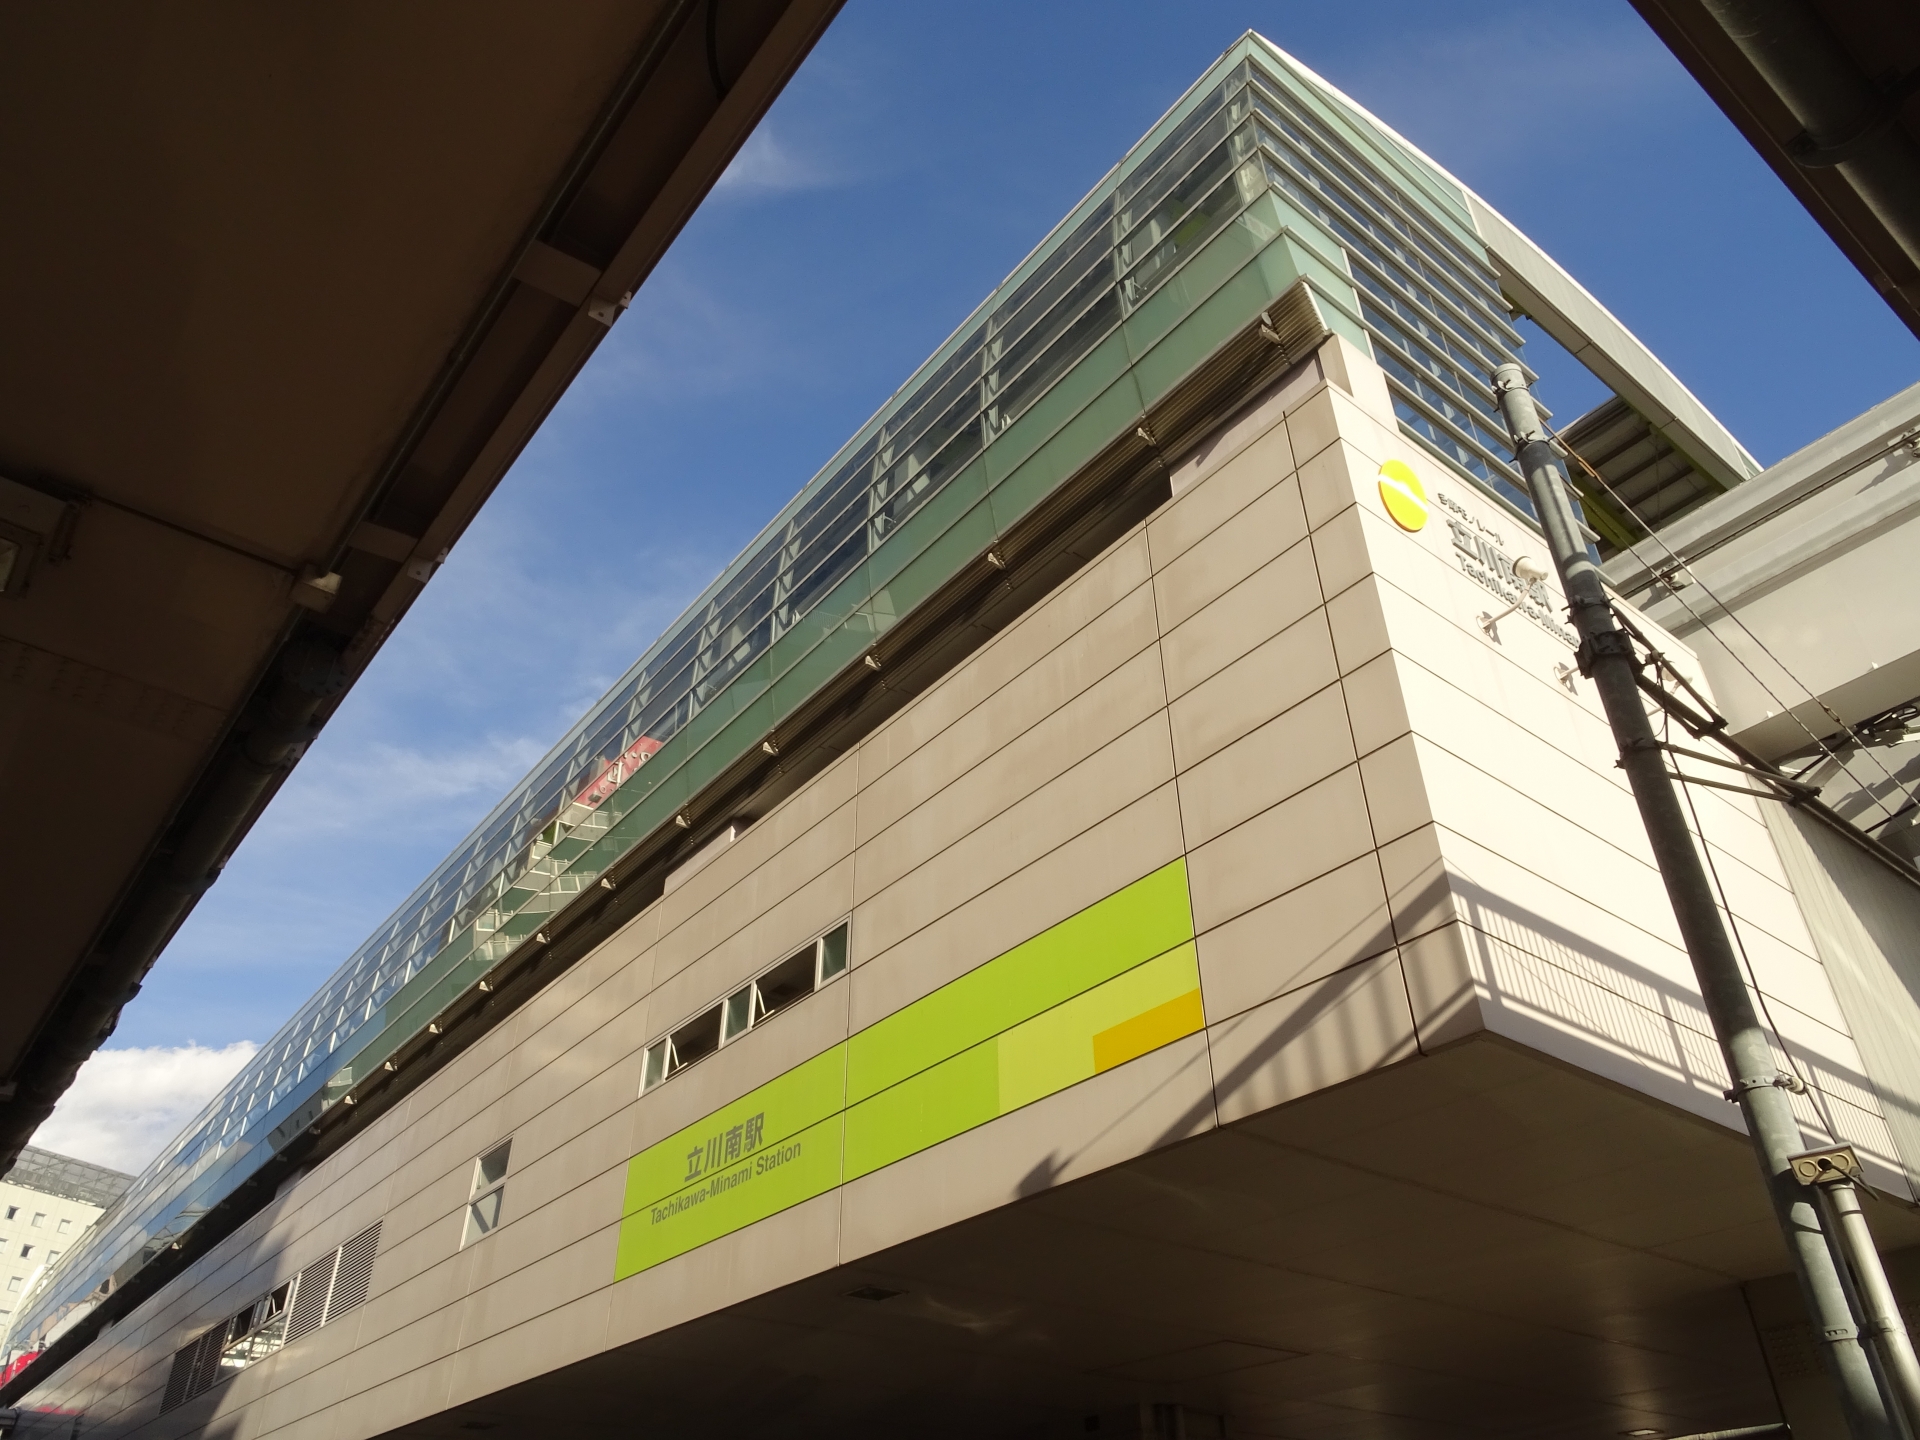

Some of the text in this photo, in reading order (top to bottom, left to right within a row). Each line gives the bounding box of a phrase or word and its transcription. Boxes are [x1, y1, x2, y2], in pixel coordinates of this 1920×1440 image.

[651, 1142, 801, 1226] Tachikawa-Minami Station
[684, 1112, 765, 1182] 立川南駅
